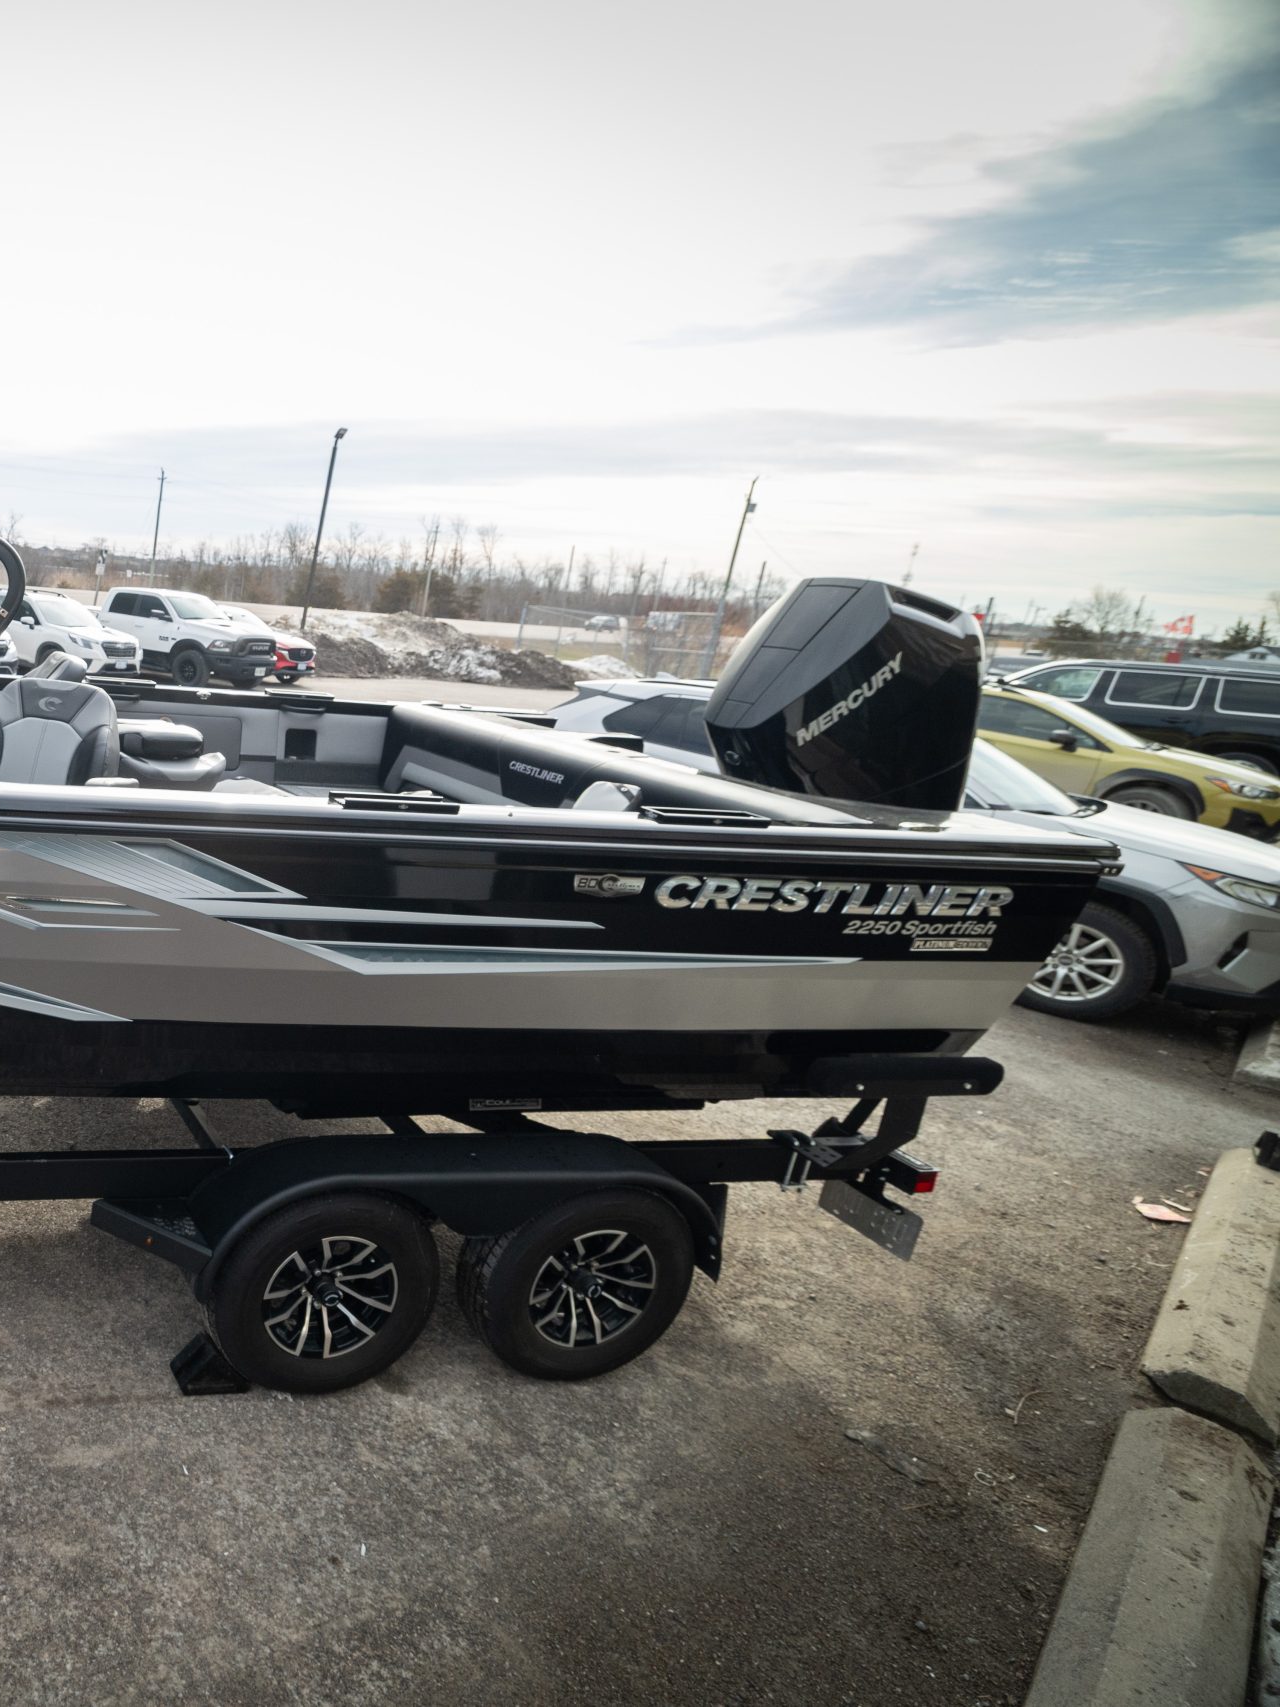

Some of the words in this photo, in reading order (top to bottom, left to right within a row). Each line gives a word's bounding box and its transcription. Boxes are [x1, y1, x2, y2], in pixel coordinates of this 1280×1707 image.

[796, 651, 903, 747] MERCURY
[509, 760, 564, 784] CRESTLINER
[654, 876, 1014, 917] CRESTLINER
[842, 920, 902, 935] 2250
[901, 920, 998, 938] Sportfish
